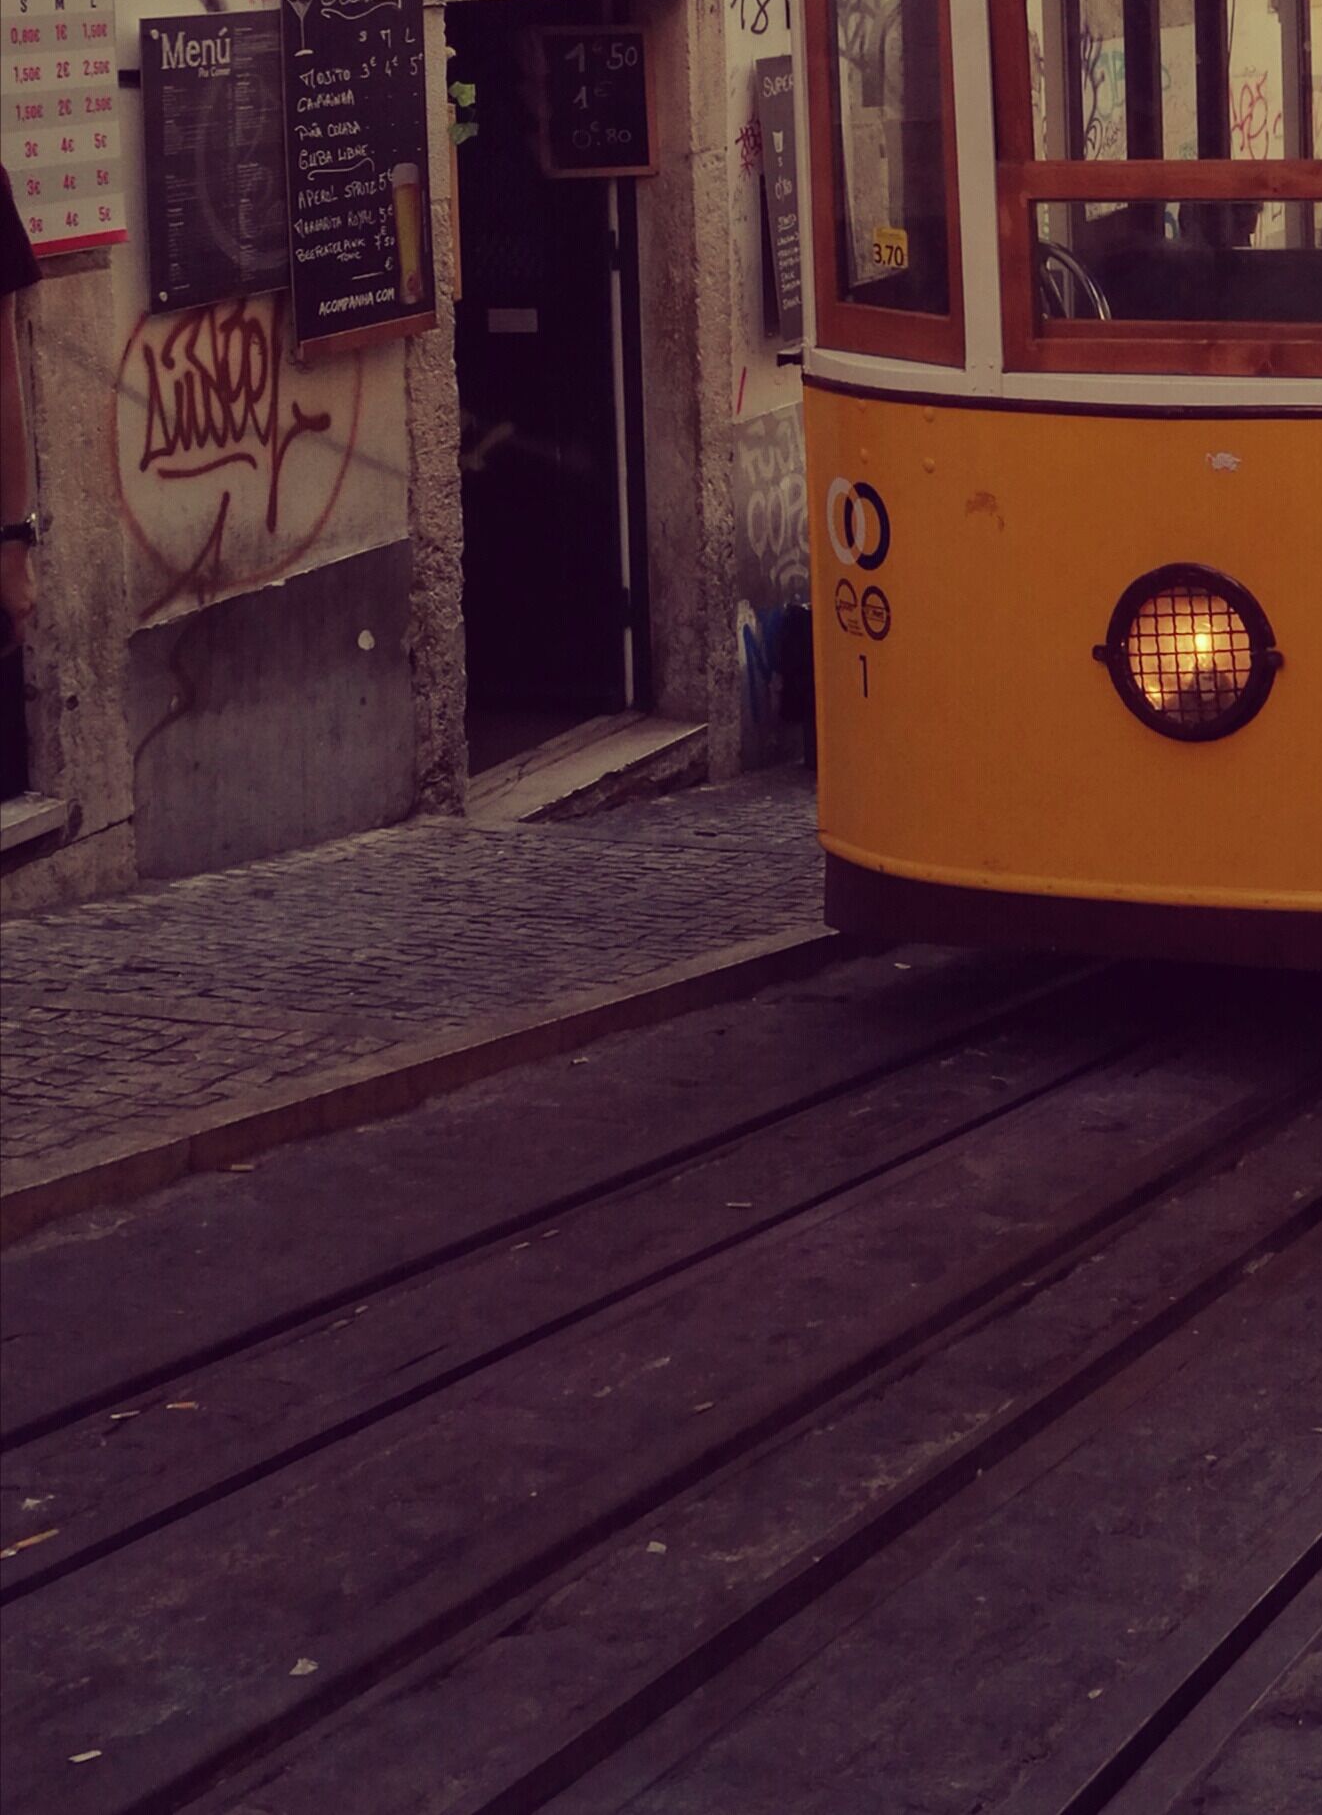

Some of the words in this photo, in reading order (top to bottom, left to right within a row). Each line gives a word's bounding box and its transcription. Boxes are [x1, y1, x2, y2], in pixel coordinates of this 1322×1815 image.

[55, 24, 68, 41] 1€
[161, 27, 231, 70] Menú
[56, 61, 70, 79] 2€
[57, 99, 72, 116] 2€
[24, 141, 39, 158] 3€
[60, 137, 75, 153] 4€
[94, 133, 108, 149] 5€
[26, 179, 41, 196] 3€
[63, 174, 77, 190] 4€
[96, 169, 110, 186] 5€
[29, 216, 43, 234] 3€
[65, 211, 79, 227] 4€
[98, 206, 112, 222] 5€
[873, 243, 904, 266] 3,70
[318, 291, 374, 316] ACOMPANHA
[375, 288, 395, 303] COM
